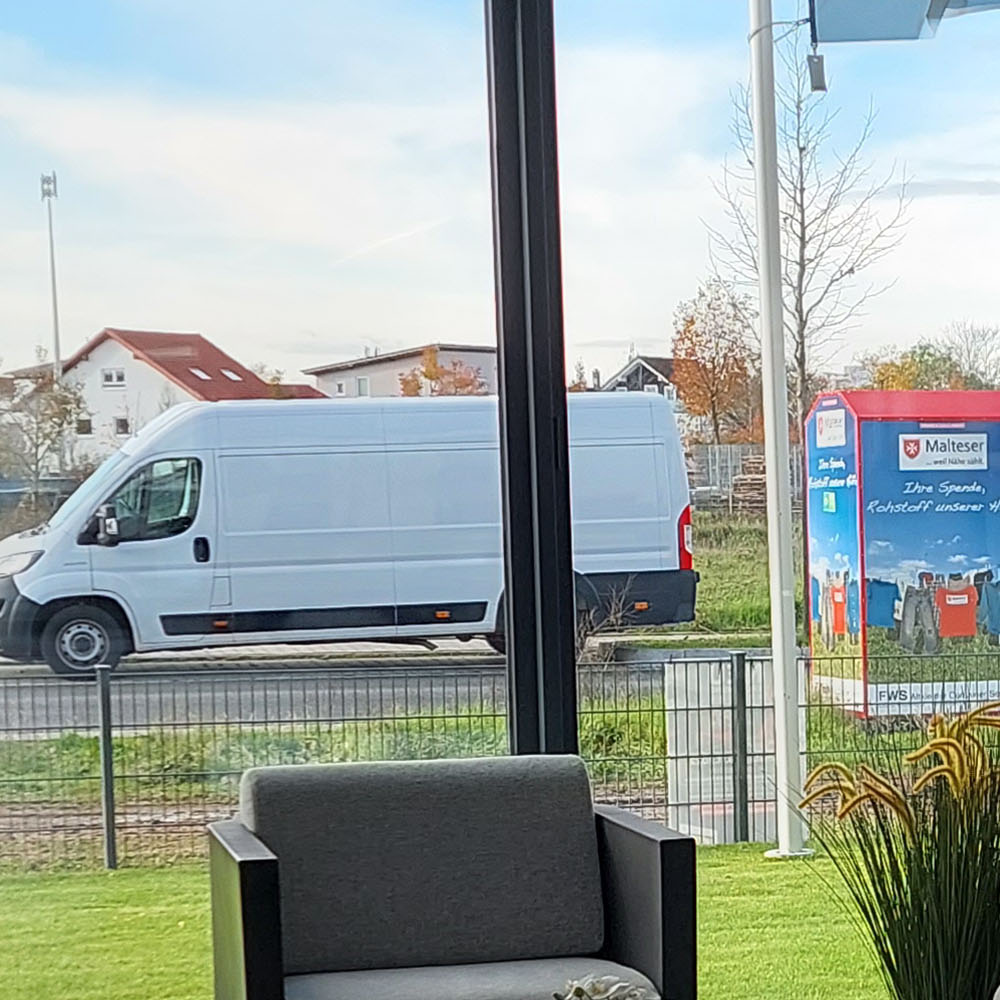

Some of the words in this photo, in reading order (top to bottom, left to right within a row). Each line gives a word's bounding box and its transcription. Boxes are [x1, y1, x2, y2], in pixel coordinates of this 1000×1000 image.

[925, 438, 985, 453] Malteser
[903, 481, 934, 494] Ihre
[938, 480, 986, 496] Spende,
[866, 500, 934, 513] Rohstoff
[935, 503, 985, 512] unserer
[879, 690, 908, 701] FWS
